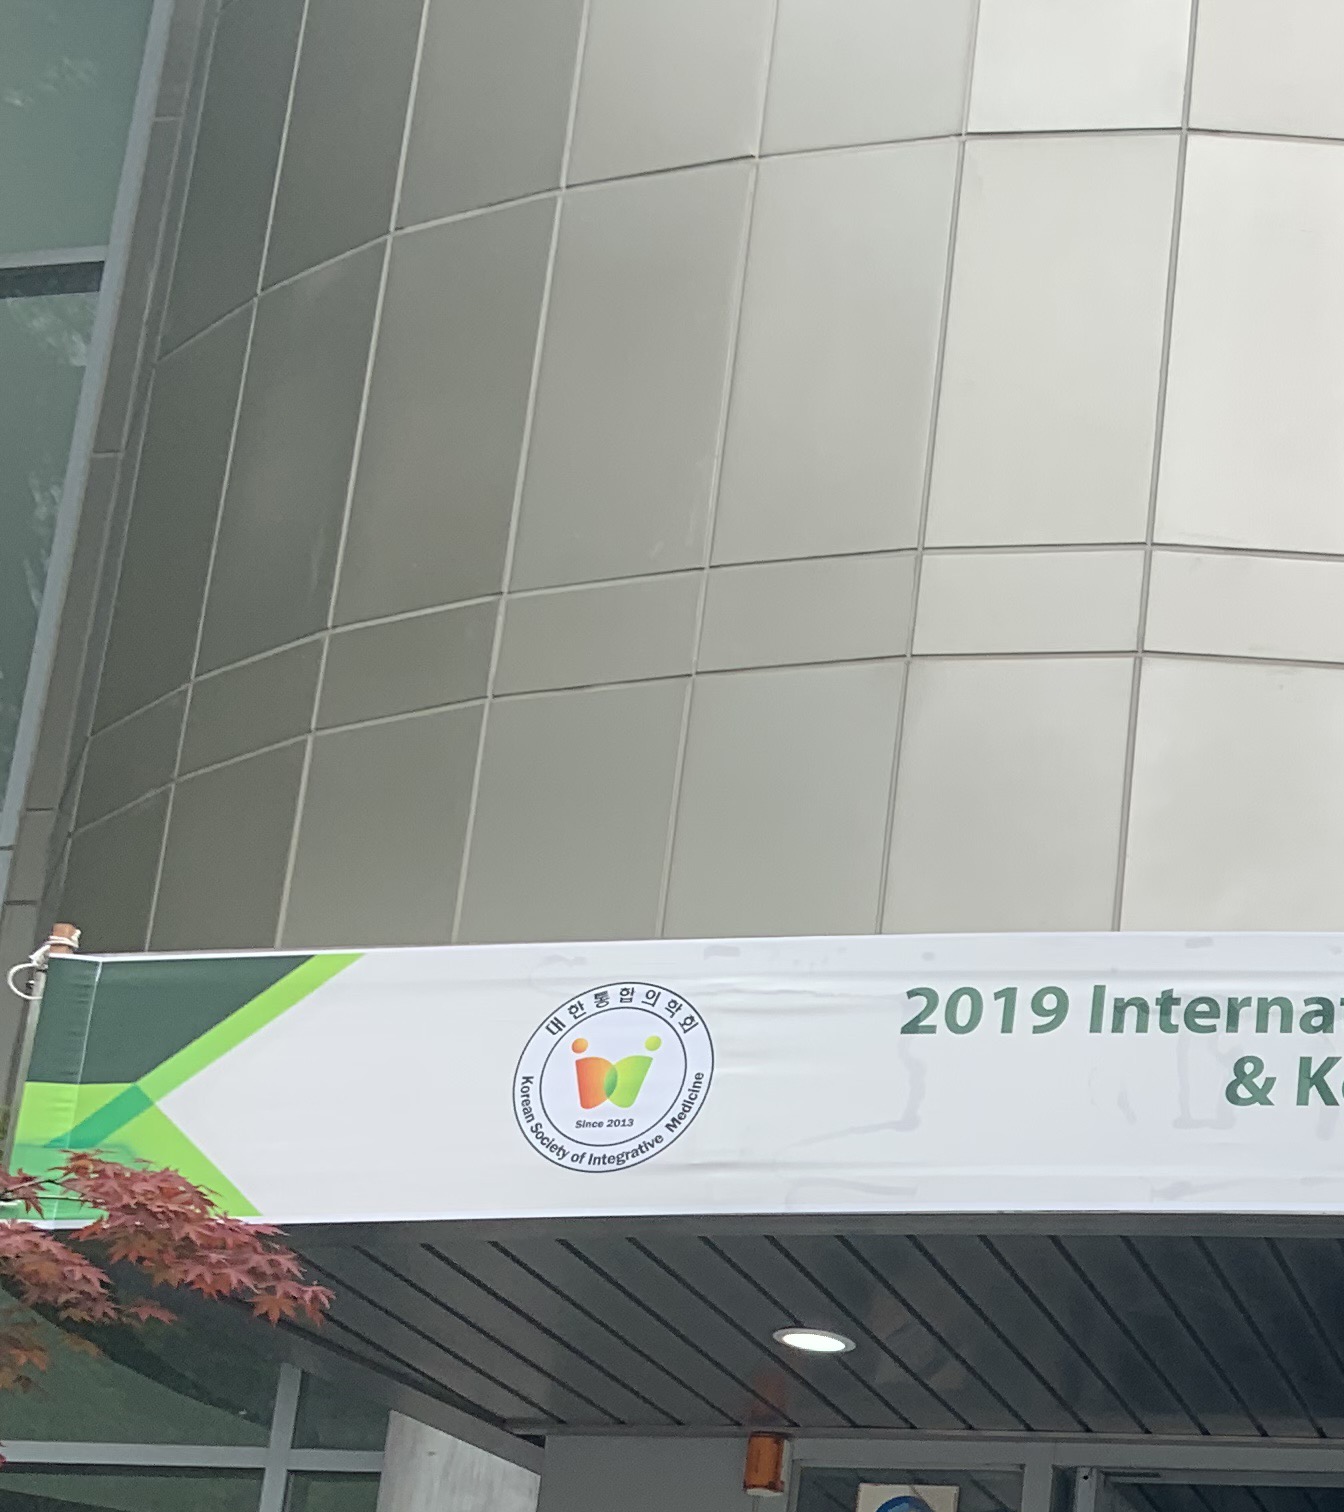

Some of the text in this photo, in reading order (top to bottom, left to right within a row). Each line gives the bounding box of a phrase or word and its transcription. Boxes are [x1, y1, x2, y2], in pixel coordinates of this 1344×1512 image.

[545, 987, 699, 1035] 대한통합의학회
[899, 985, 1070, 1035] 2019
[1224, 1055, 1277, 1107] &
[520, 1072, 705, 1166] Korean Society of Integrative Medicine
[575, 1118, 634, 1129] Since 2013
